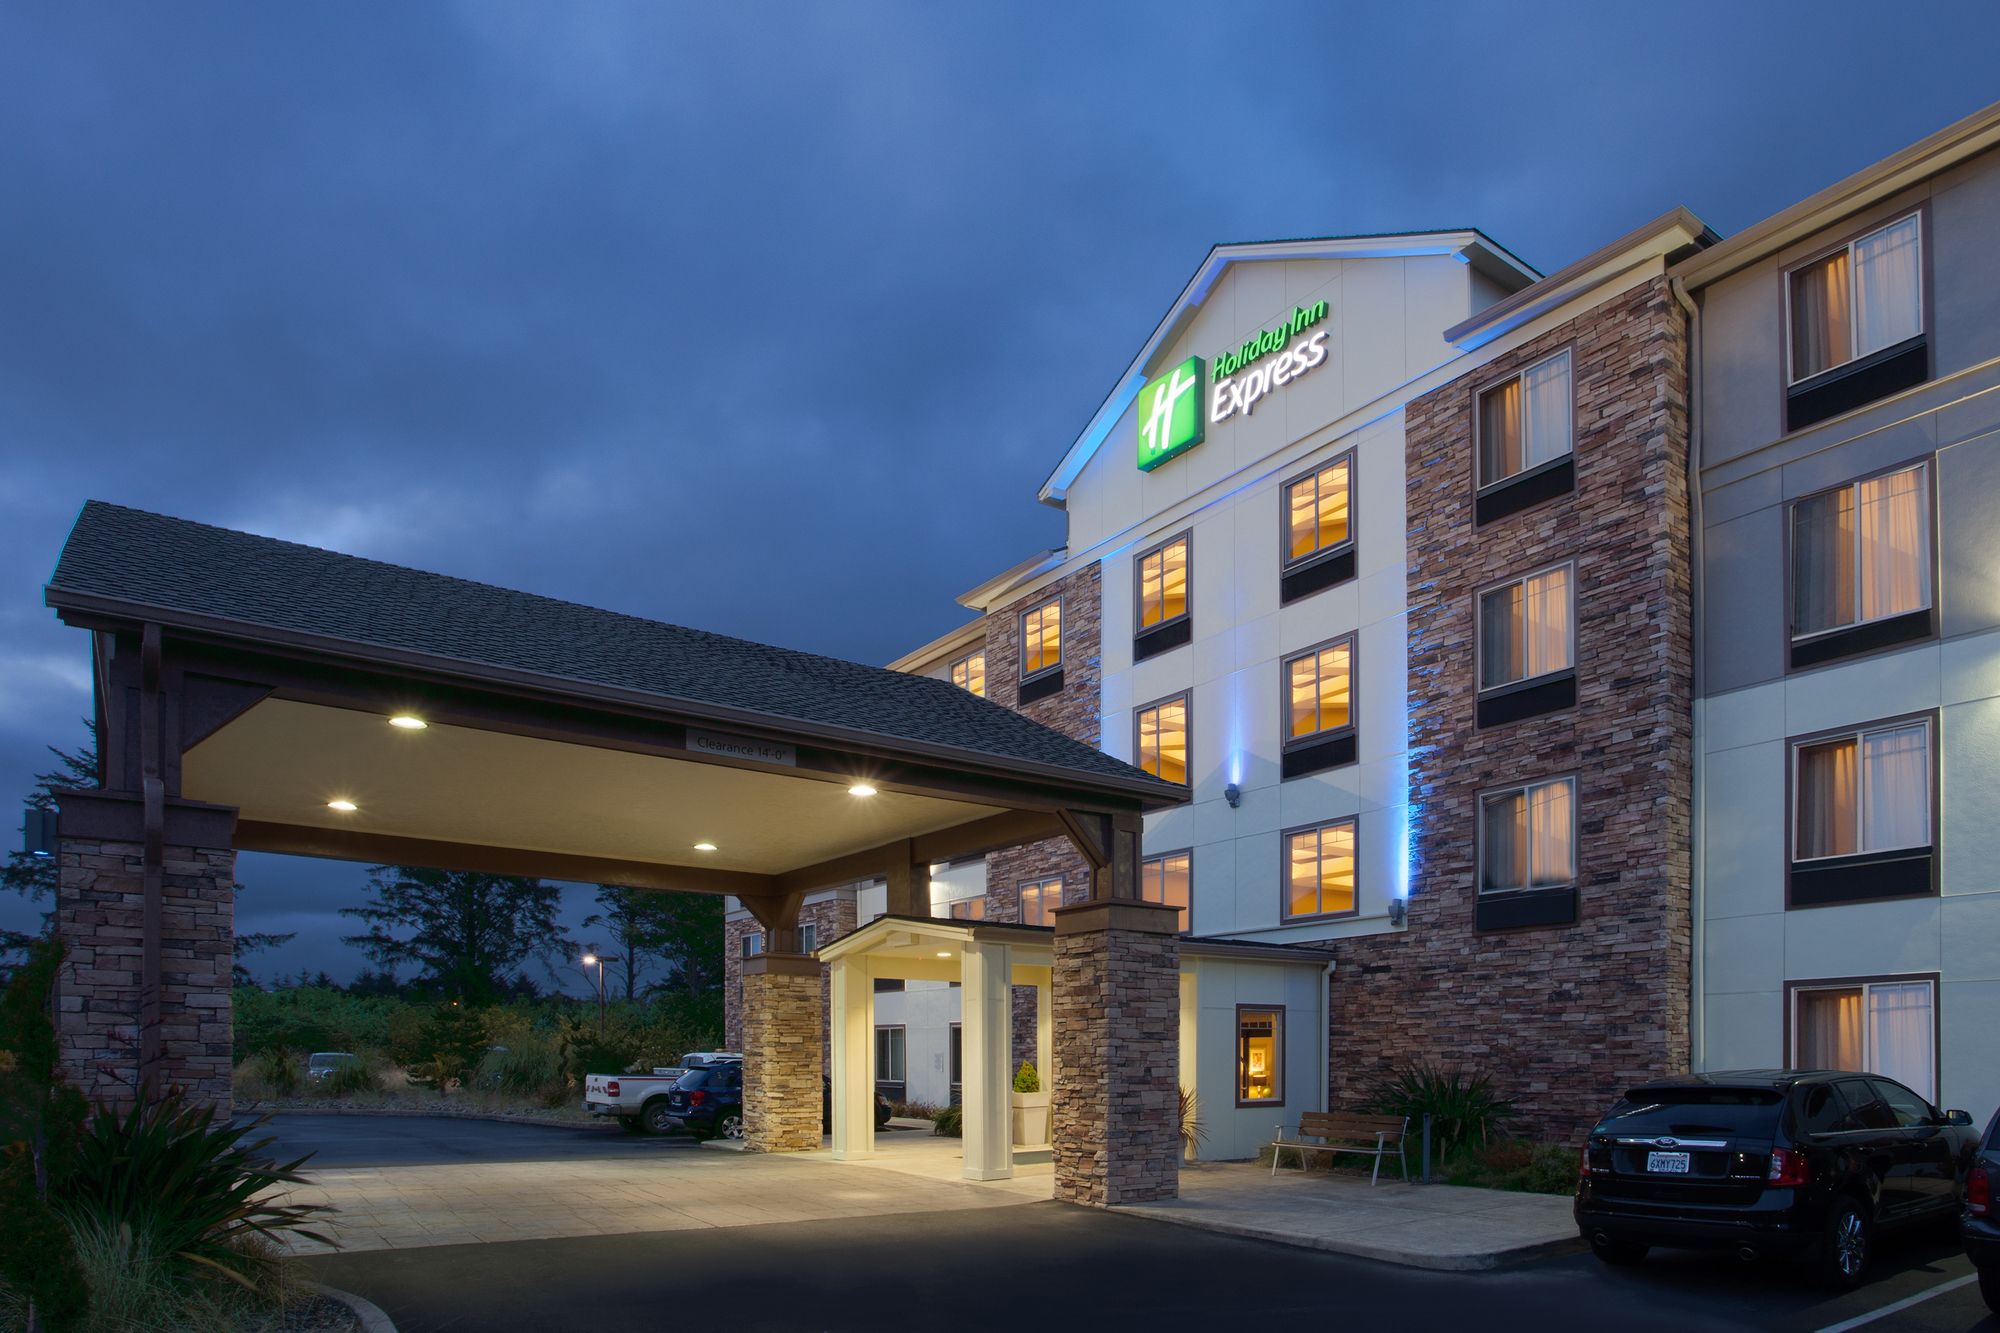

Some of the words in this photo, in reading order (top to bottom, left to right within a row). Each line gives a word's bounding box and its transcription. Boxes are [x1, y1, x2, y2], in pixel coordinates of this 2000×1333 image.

[1211, 322, 1290, 383] Holiday
[1290, 300, 1329, 335] Inn
[1211, 331, 1329, 423] Express
[697, 735, 754, 756] Clearance
[1650, 1159, 1686, 1170] 6XMY725
